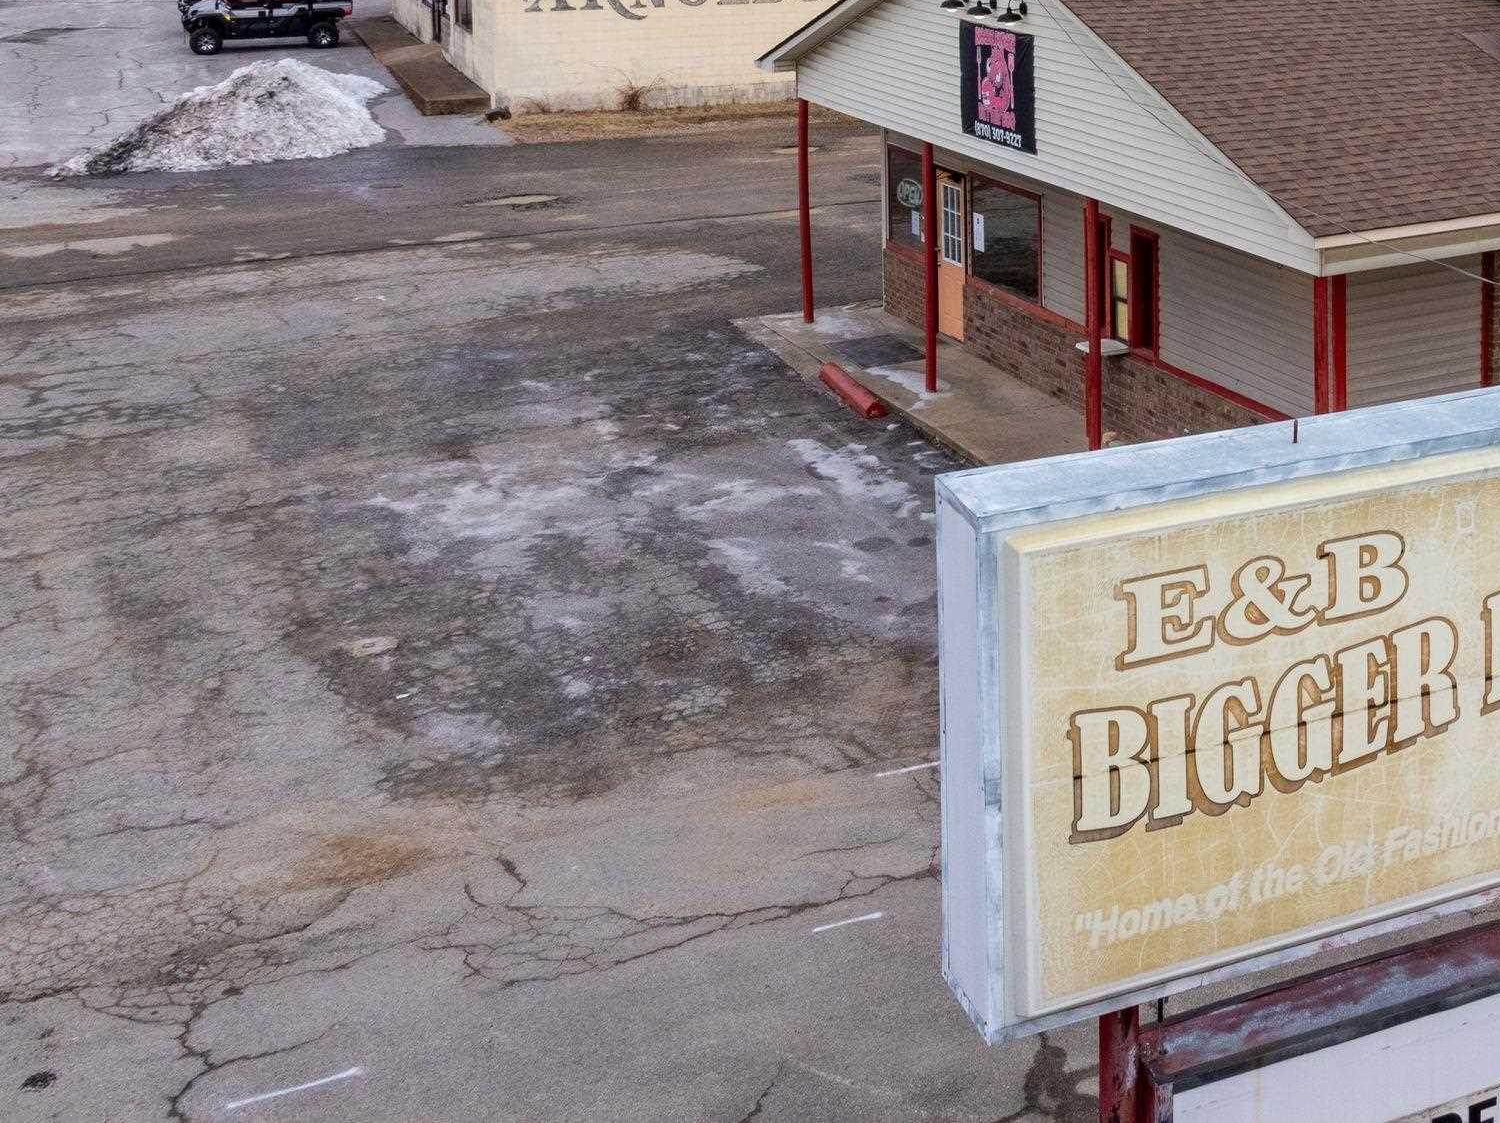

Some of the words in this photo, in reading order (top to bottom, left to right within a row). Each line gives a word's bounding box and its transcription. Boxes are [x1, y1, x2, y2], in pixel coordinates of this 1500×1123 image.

[897, 180, 921, 205] OPEN
[1113, 529, 1409, 671] E&B
[1067, 616, 1460, 844] BIGGER
[1076, 891, 1196, 949] "Home
[1203, 872, 1249, 914] of
[1251, 858, 1304, 906] the
[1314, 834, 1375, 885] Old
